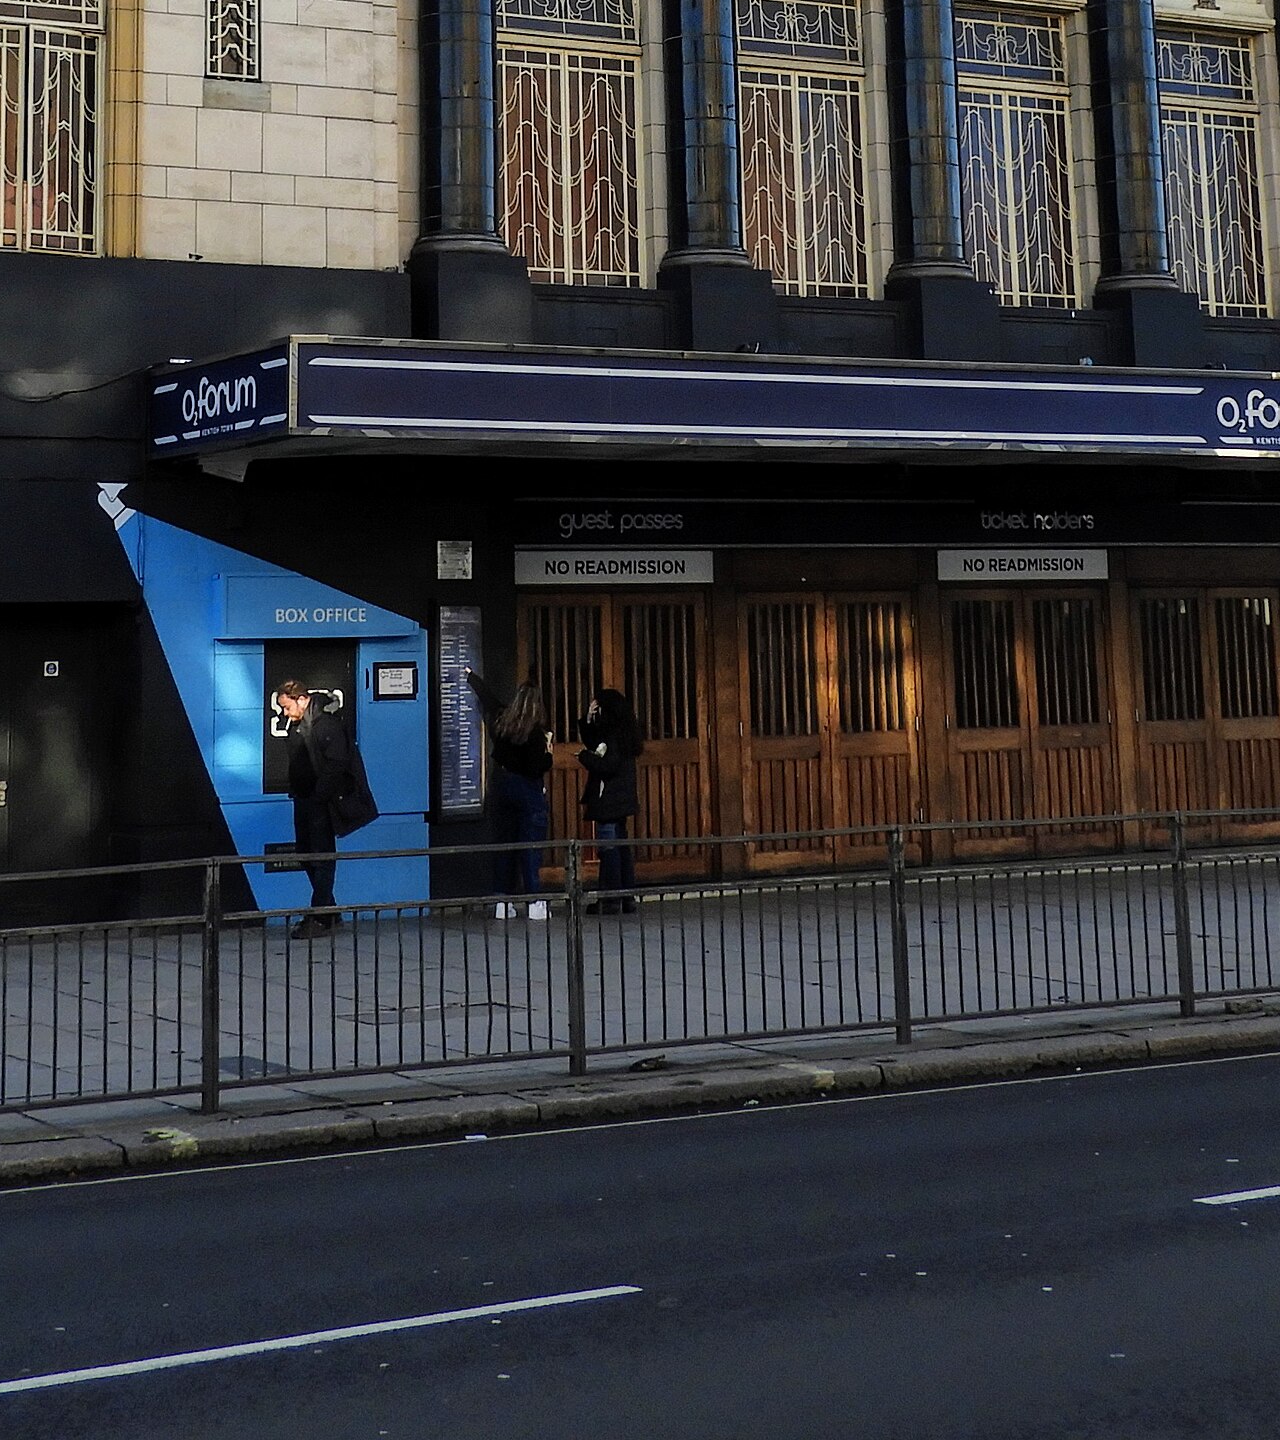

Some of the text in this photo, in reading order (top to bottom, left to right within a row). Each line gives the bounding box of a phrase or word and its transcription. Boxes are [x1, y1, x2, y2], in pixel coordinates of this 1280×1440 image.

[558, 510, 684, 539] guest passes
[980, 511, 1095, 530] ticket holders
[545, 560, 686, 575] NO READMISSION
[963, 558, 1084, 572] NO READMISSION
[275, 607, 367, 623] BOX OFFICE
